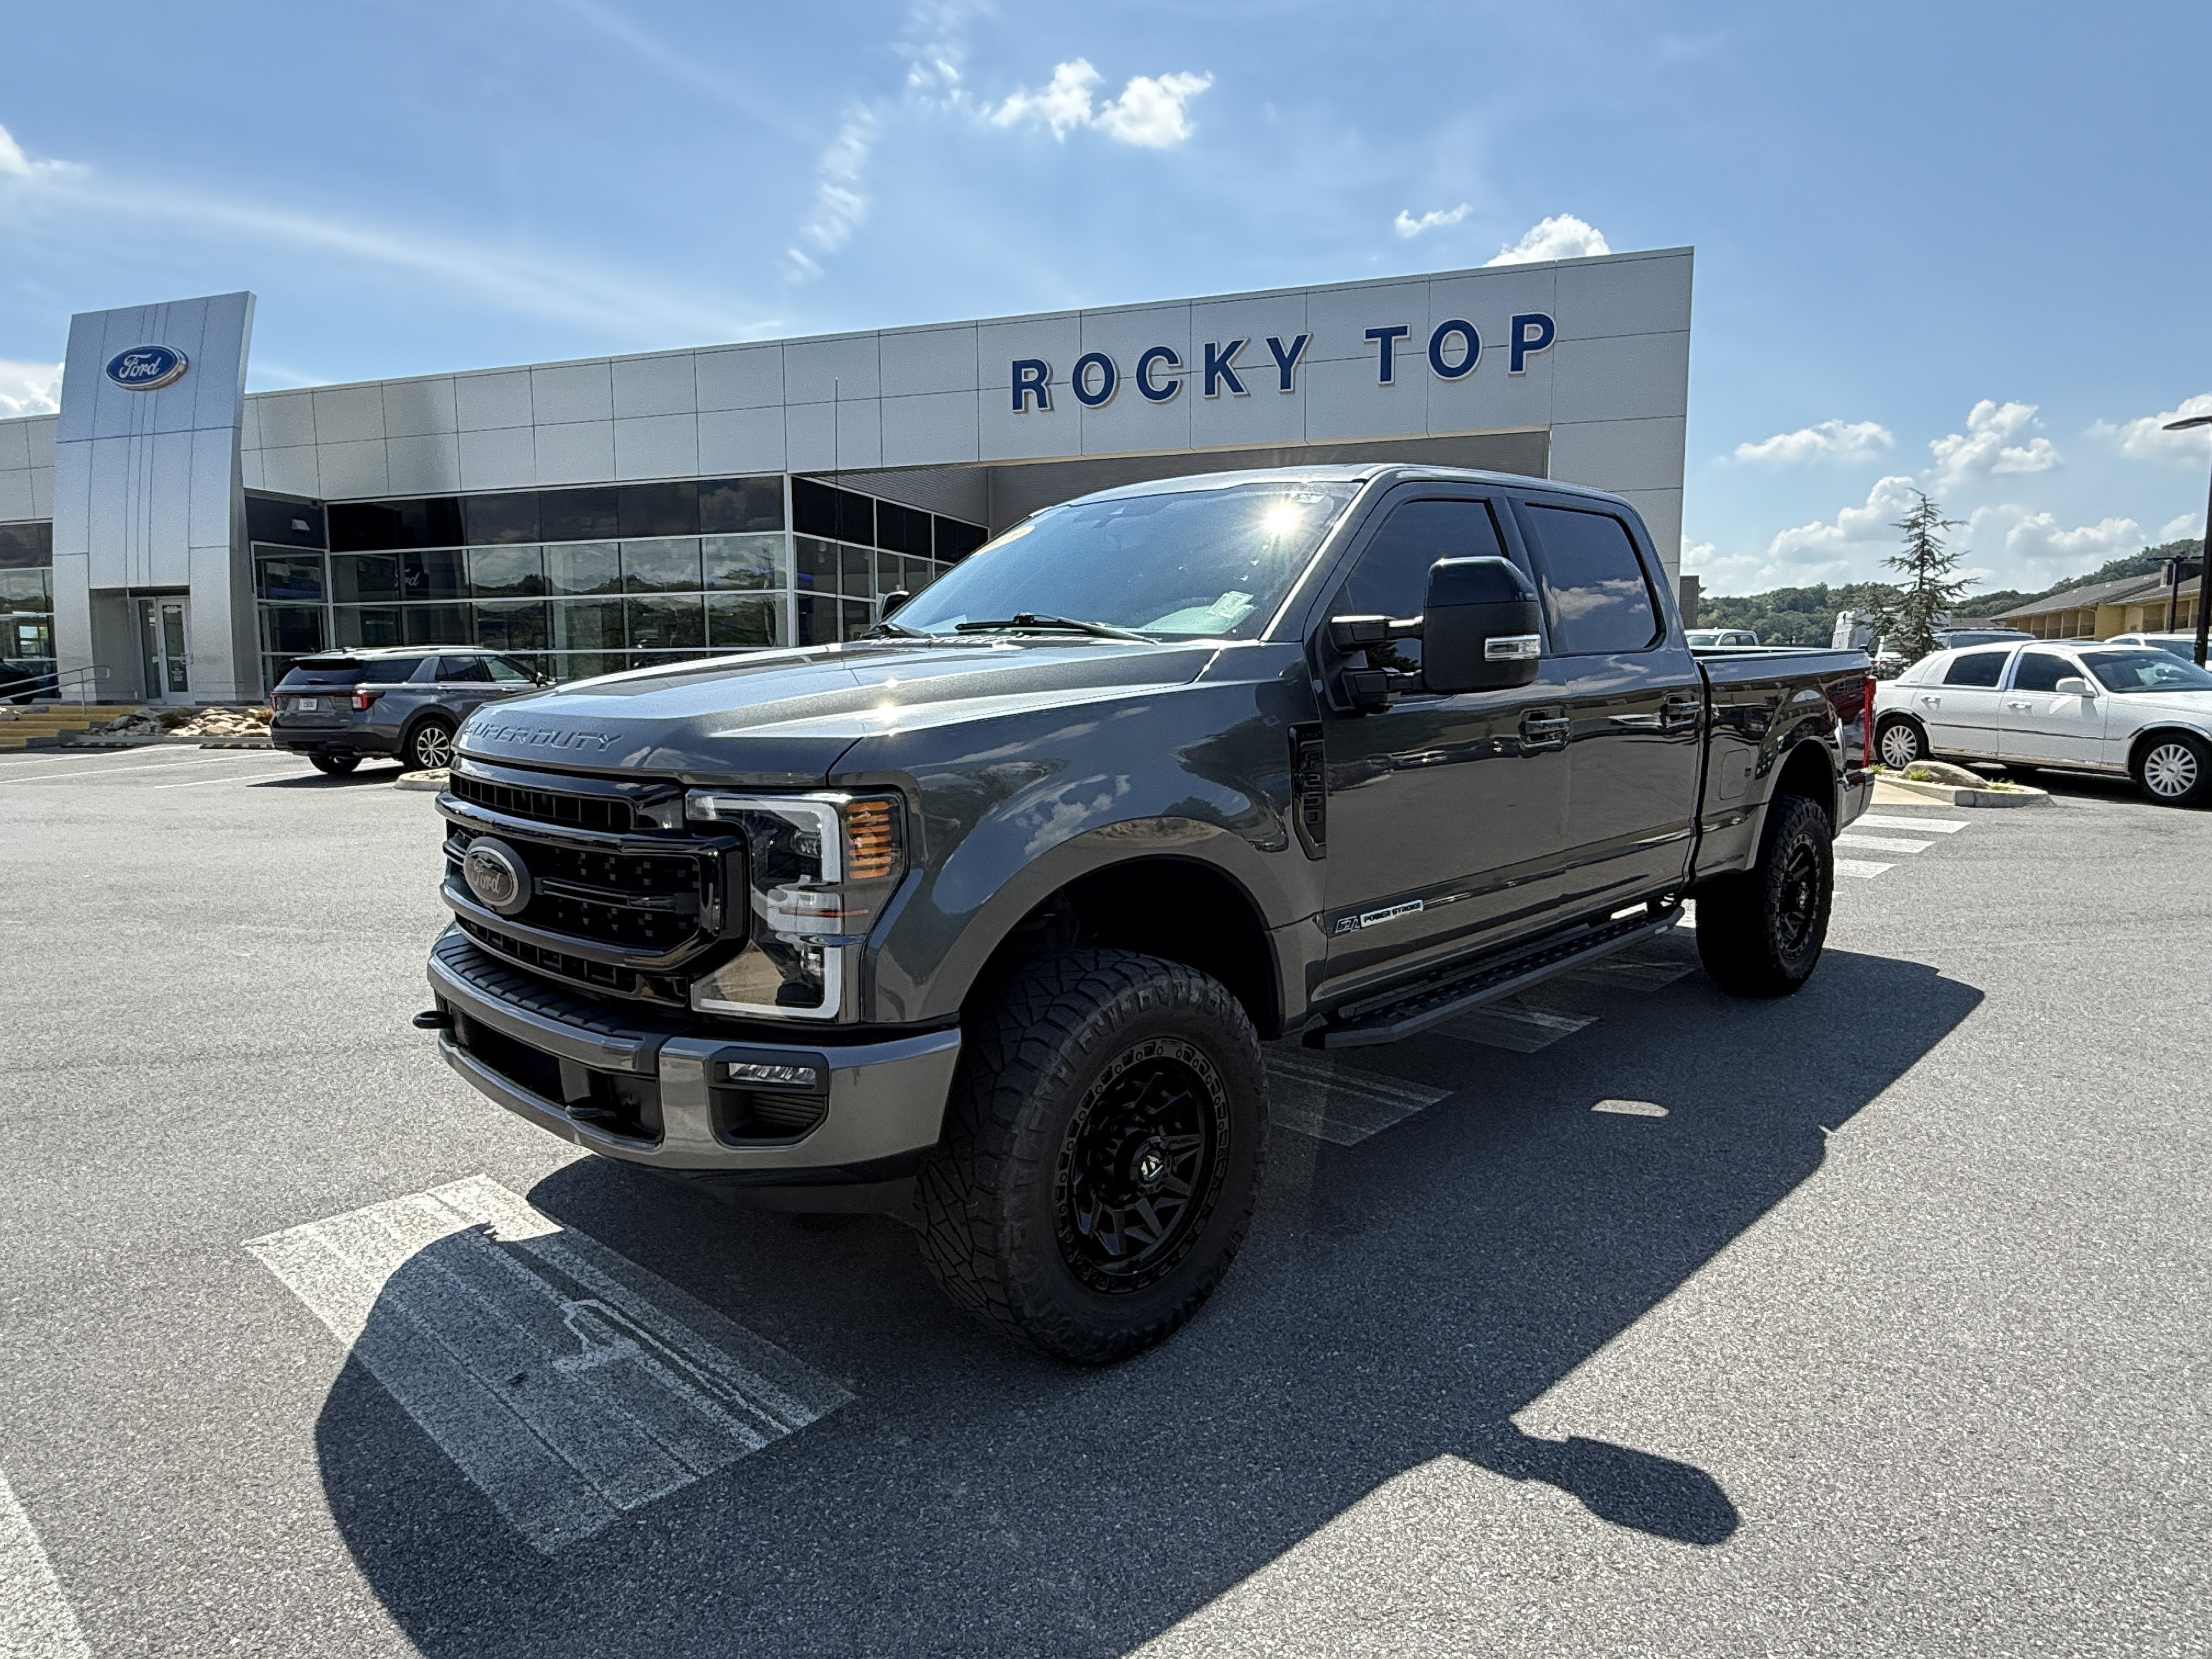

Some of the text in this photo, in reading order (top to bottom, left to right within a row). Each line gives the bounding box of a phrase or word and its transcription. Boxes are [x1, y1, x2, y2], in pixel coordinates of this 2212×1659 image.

[119, 353, 162, 379] Ford
[1011, 312, 1557, 413] ROCKY TOP
[464, 721, 624, 752] SUPER DUTY
[470, 857, 501, 894] Ford
